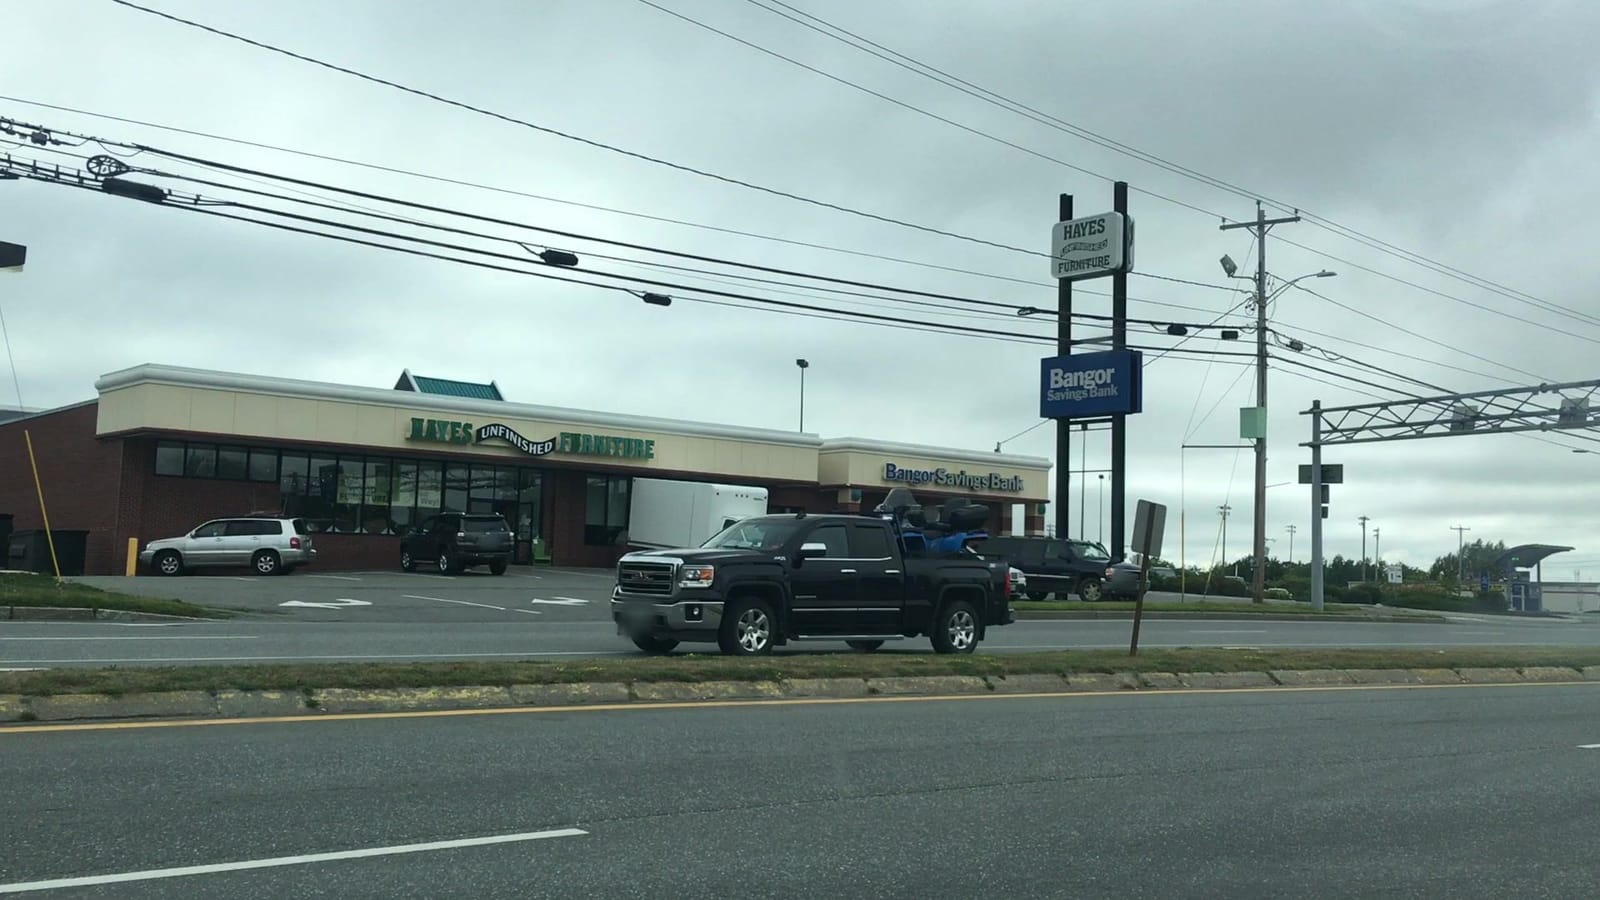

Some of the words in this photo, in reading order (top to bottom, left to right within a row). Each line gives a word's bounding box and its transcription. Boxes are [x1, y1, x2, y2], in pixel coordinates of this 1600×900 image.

[1063, 218, 1106, 241] HAYES
[1058, 255, 1111, 274] FURNITURE
[1050, 367, 1116, 389] Bangor
[1047, 388, 1089, 402] Savings
[1089, 384, 1119, 398] Bank
[481, 424, 554, 456] UNFINISHED
[558, 431, 656, 460] FURNITURE
[884, 463, 936, 485] Bangor
[935, 468, 988, 491] Savings
[989, 472, 1025, 491] Bank
